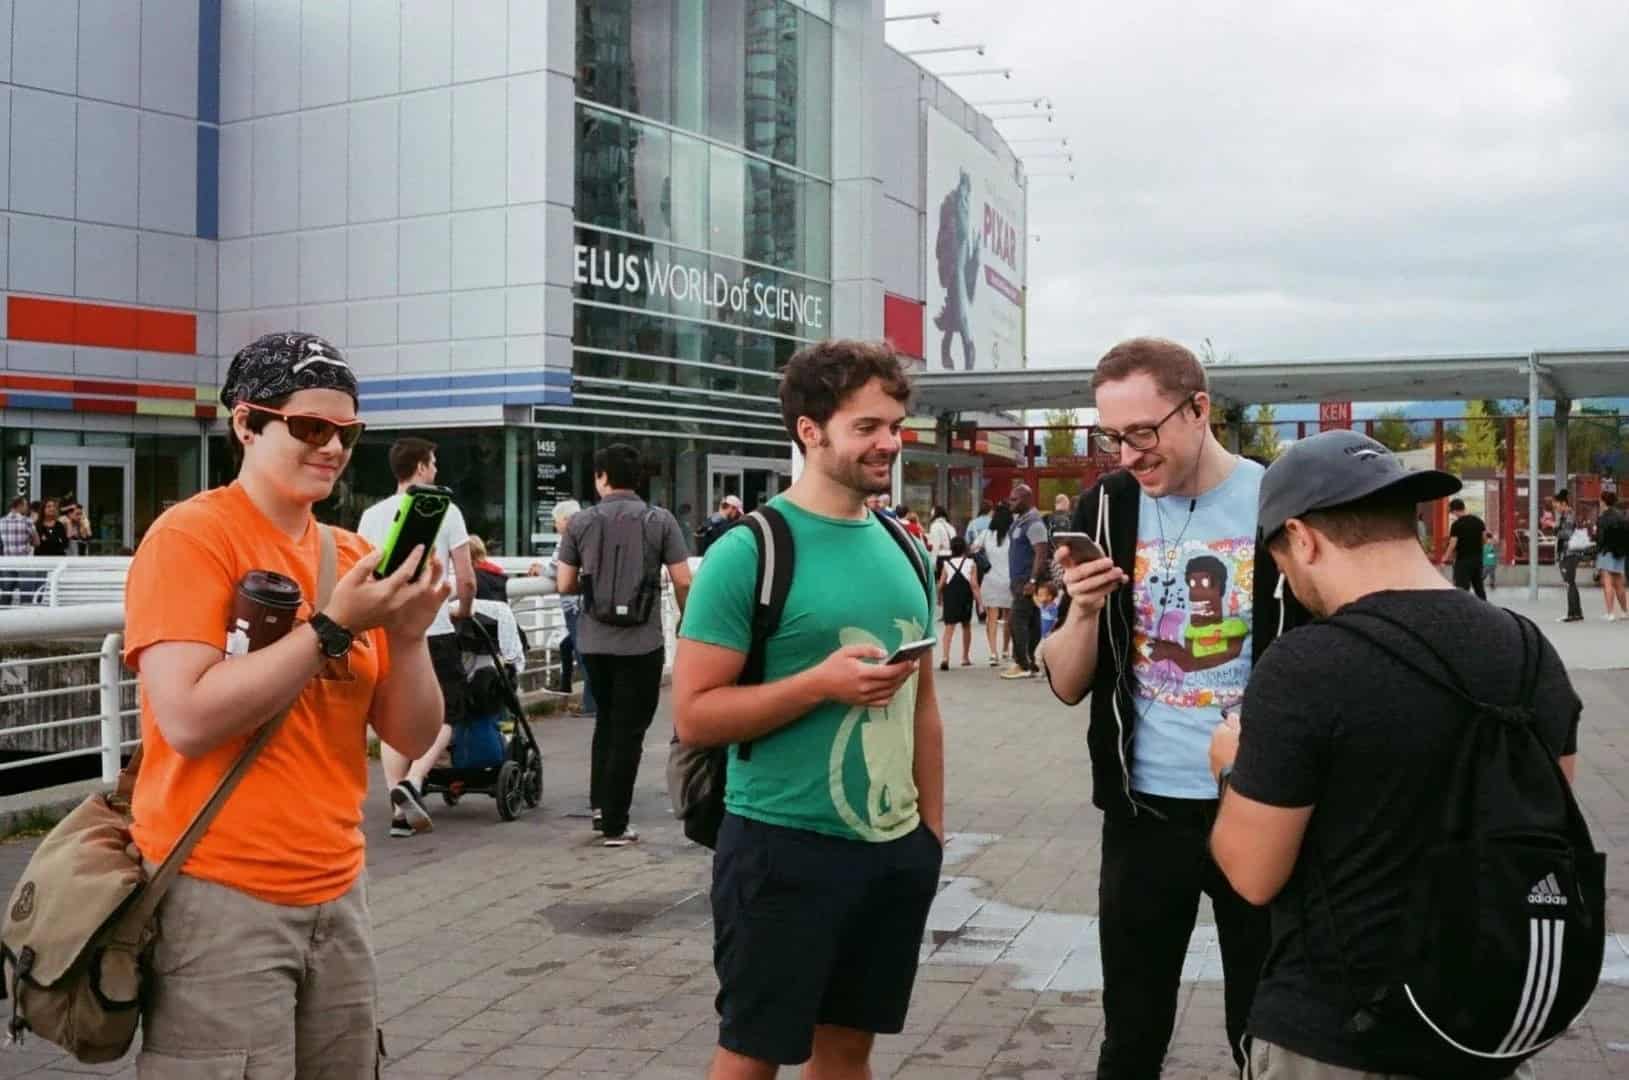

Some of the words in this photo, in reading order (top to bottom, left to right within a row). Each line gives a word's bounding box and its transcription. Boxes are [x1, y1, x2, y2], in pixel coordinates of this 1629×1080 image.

[984, 202, 1016, 271] PIXAR
[573, 245, 641, 292] ELUS
[643, 254, 729, 307] WORLD
[730, 278, 750, 312] of
[753, 282, 823, 328] SCIENCE
[1321, 403, 1347, 421] KEN
[15, 456, 31, 495] cope
[1527, 894, 1568, 905] adidas
